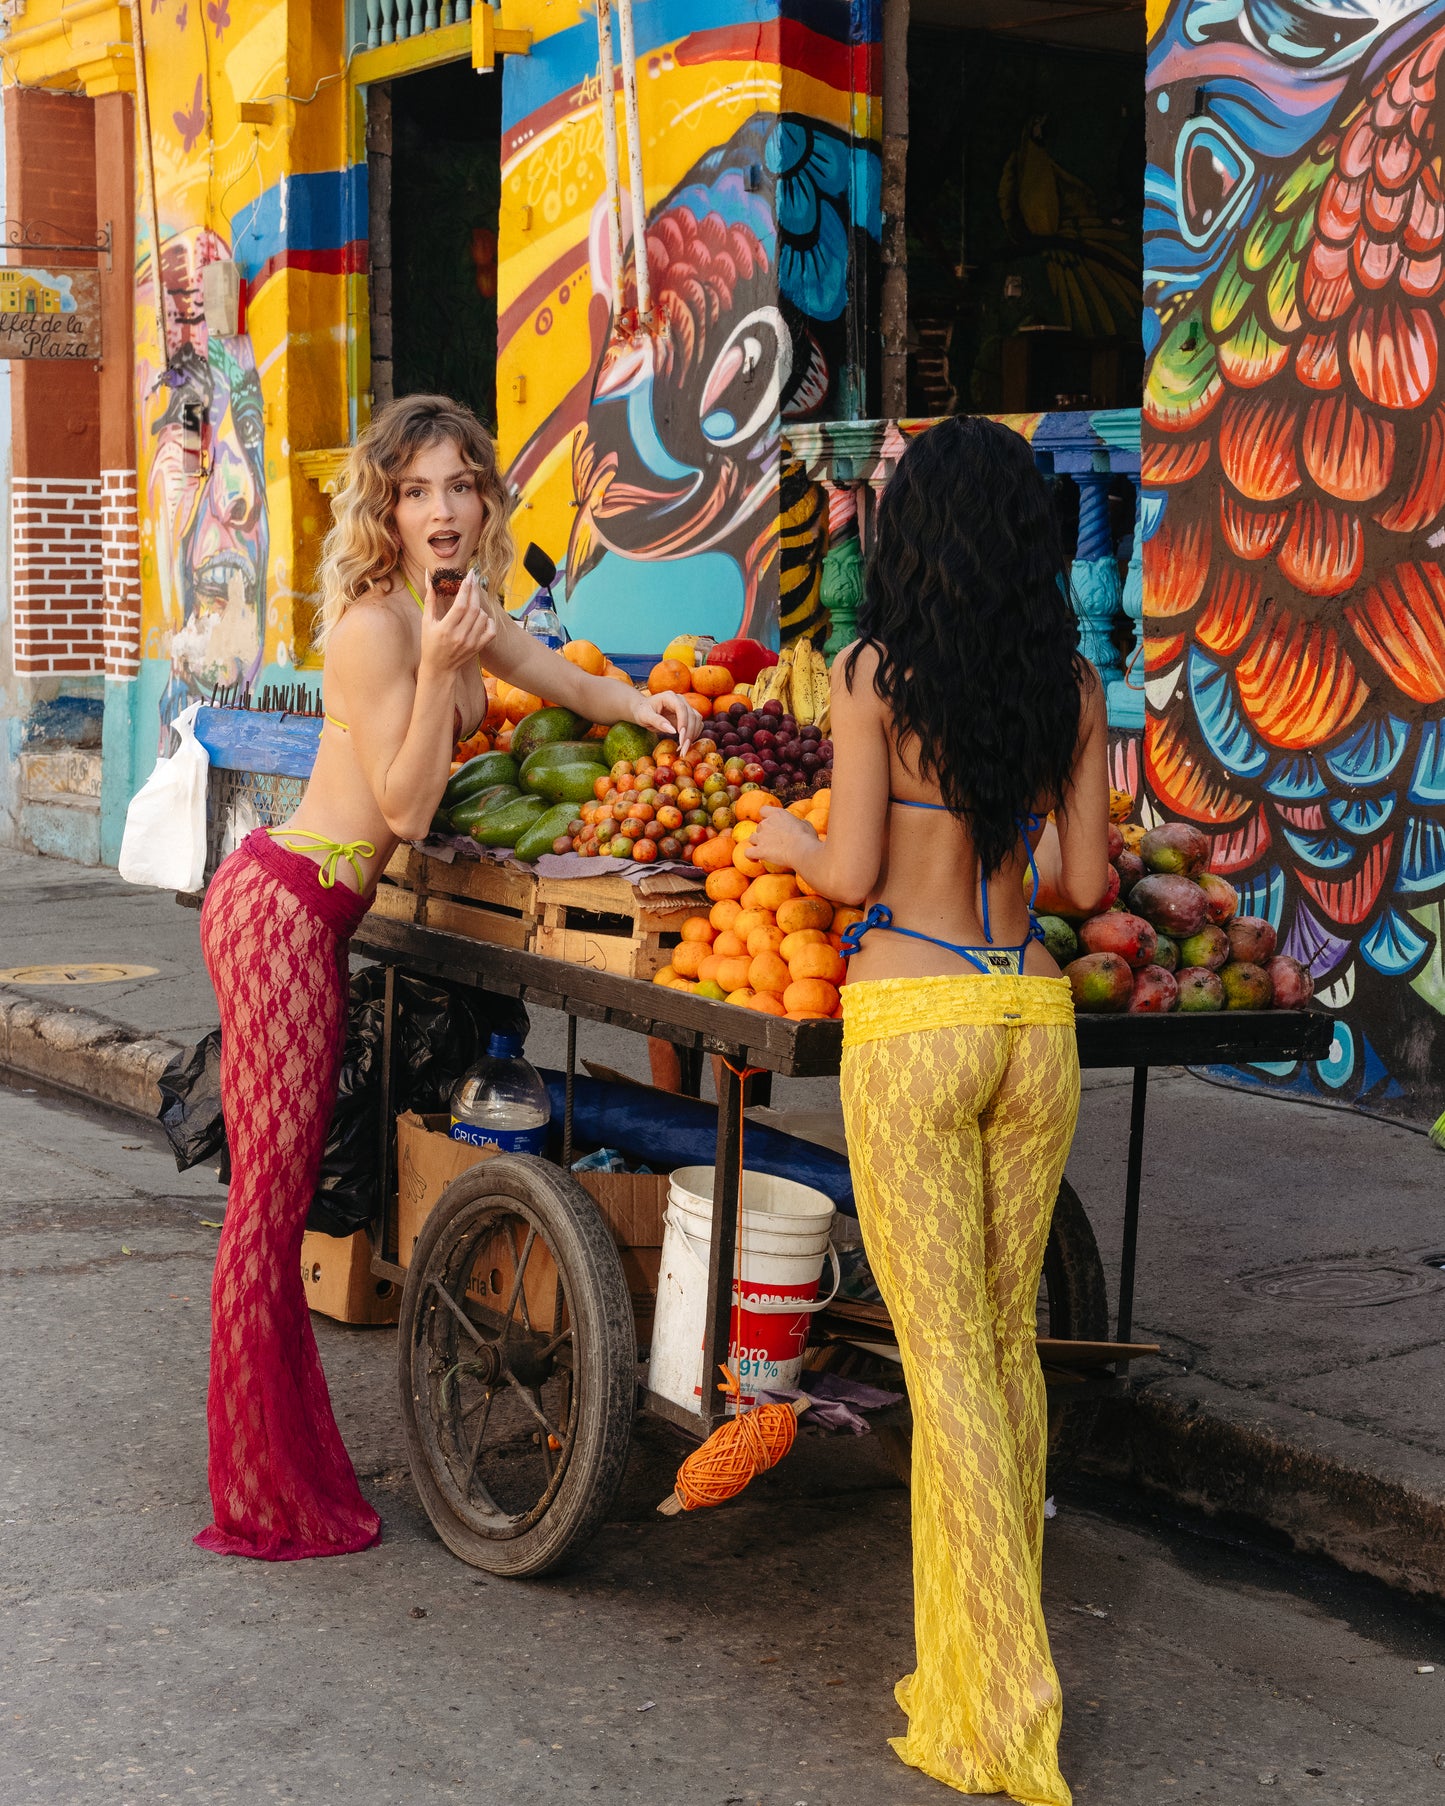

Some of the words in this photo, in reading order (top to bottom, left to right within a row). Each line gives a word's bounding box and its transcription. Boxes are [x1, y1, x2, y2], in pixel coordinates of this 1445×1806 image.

[41, 314, 62, 333] de
[67, 315, 84, 334] la
[22, 332, 88, 357] Plaza
[728, 1341, 769, 1361] loro
[739, 1360, 779, 1378] 91%
